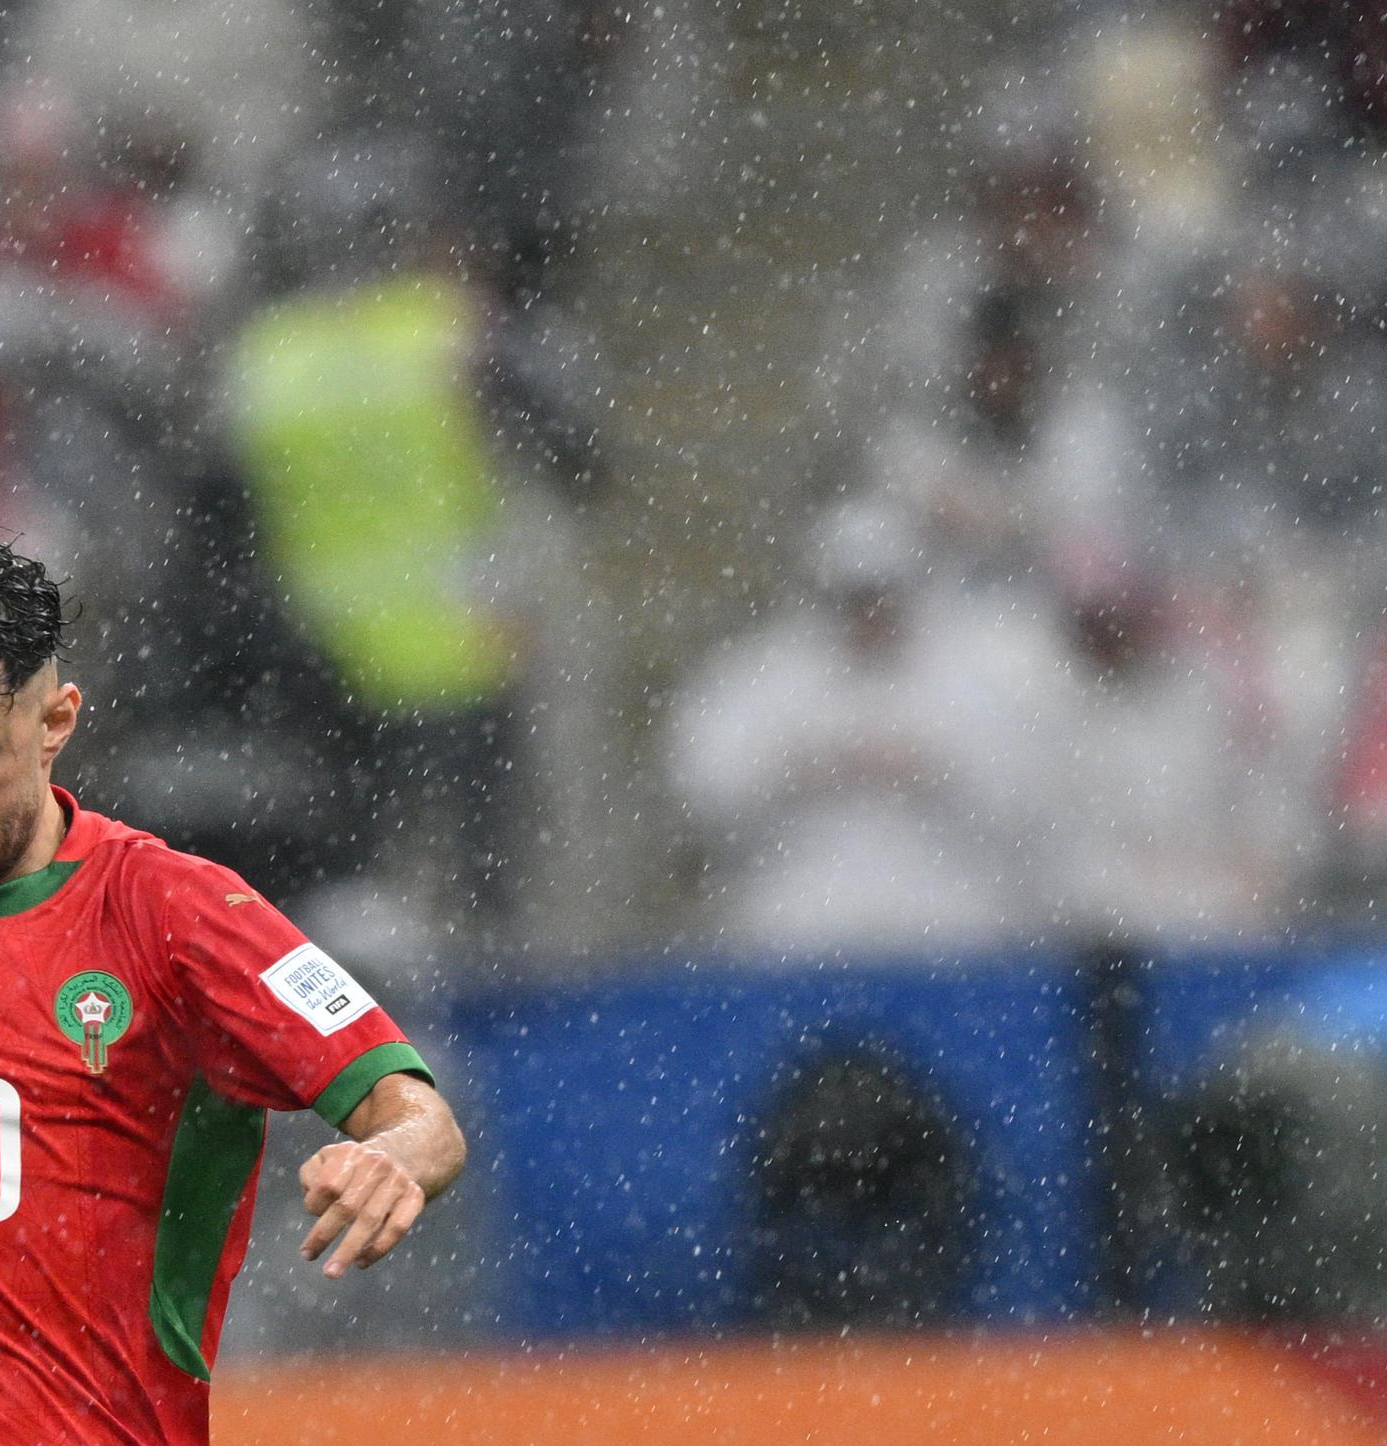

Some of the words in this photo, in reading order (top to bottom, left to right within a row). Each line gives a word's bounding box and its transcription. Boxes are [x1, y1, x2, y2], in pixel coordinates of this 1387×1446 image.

[284, 958, 323, 986] FOOTBALL
[293, 966, 335, 999] UNITES
[306, 998, 323, 1011] the
[318, 979, 347, 1001] World
[328, 996, 348, 1014] FIFA
